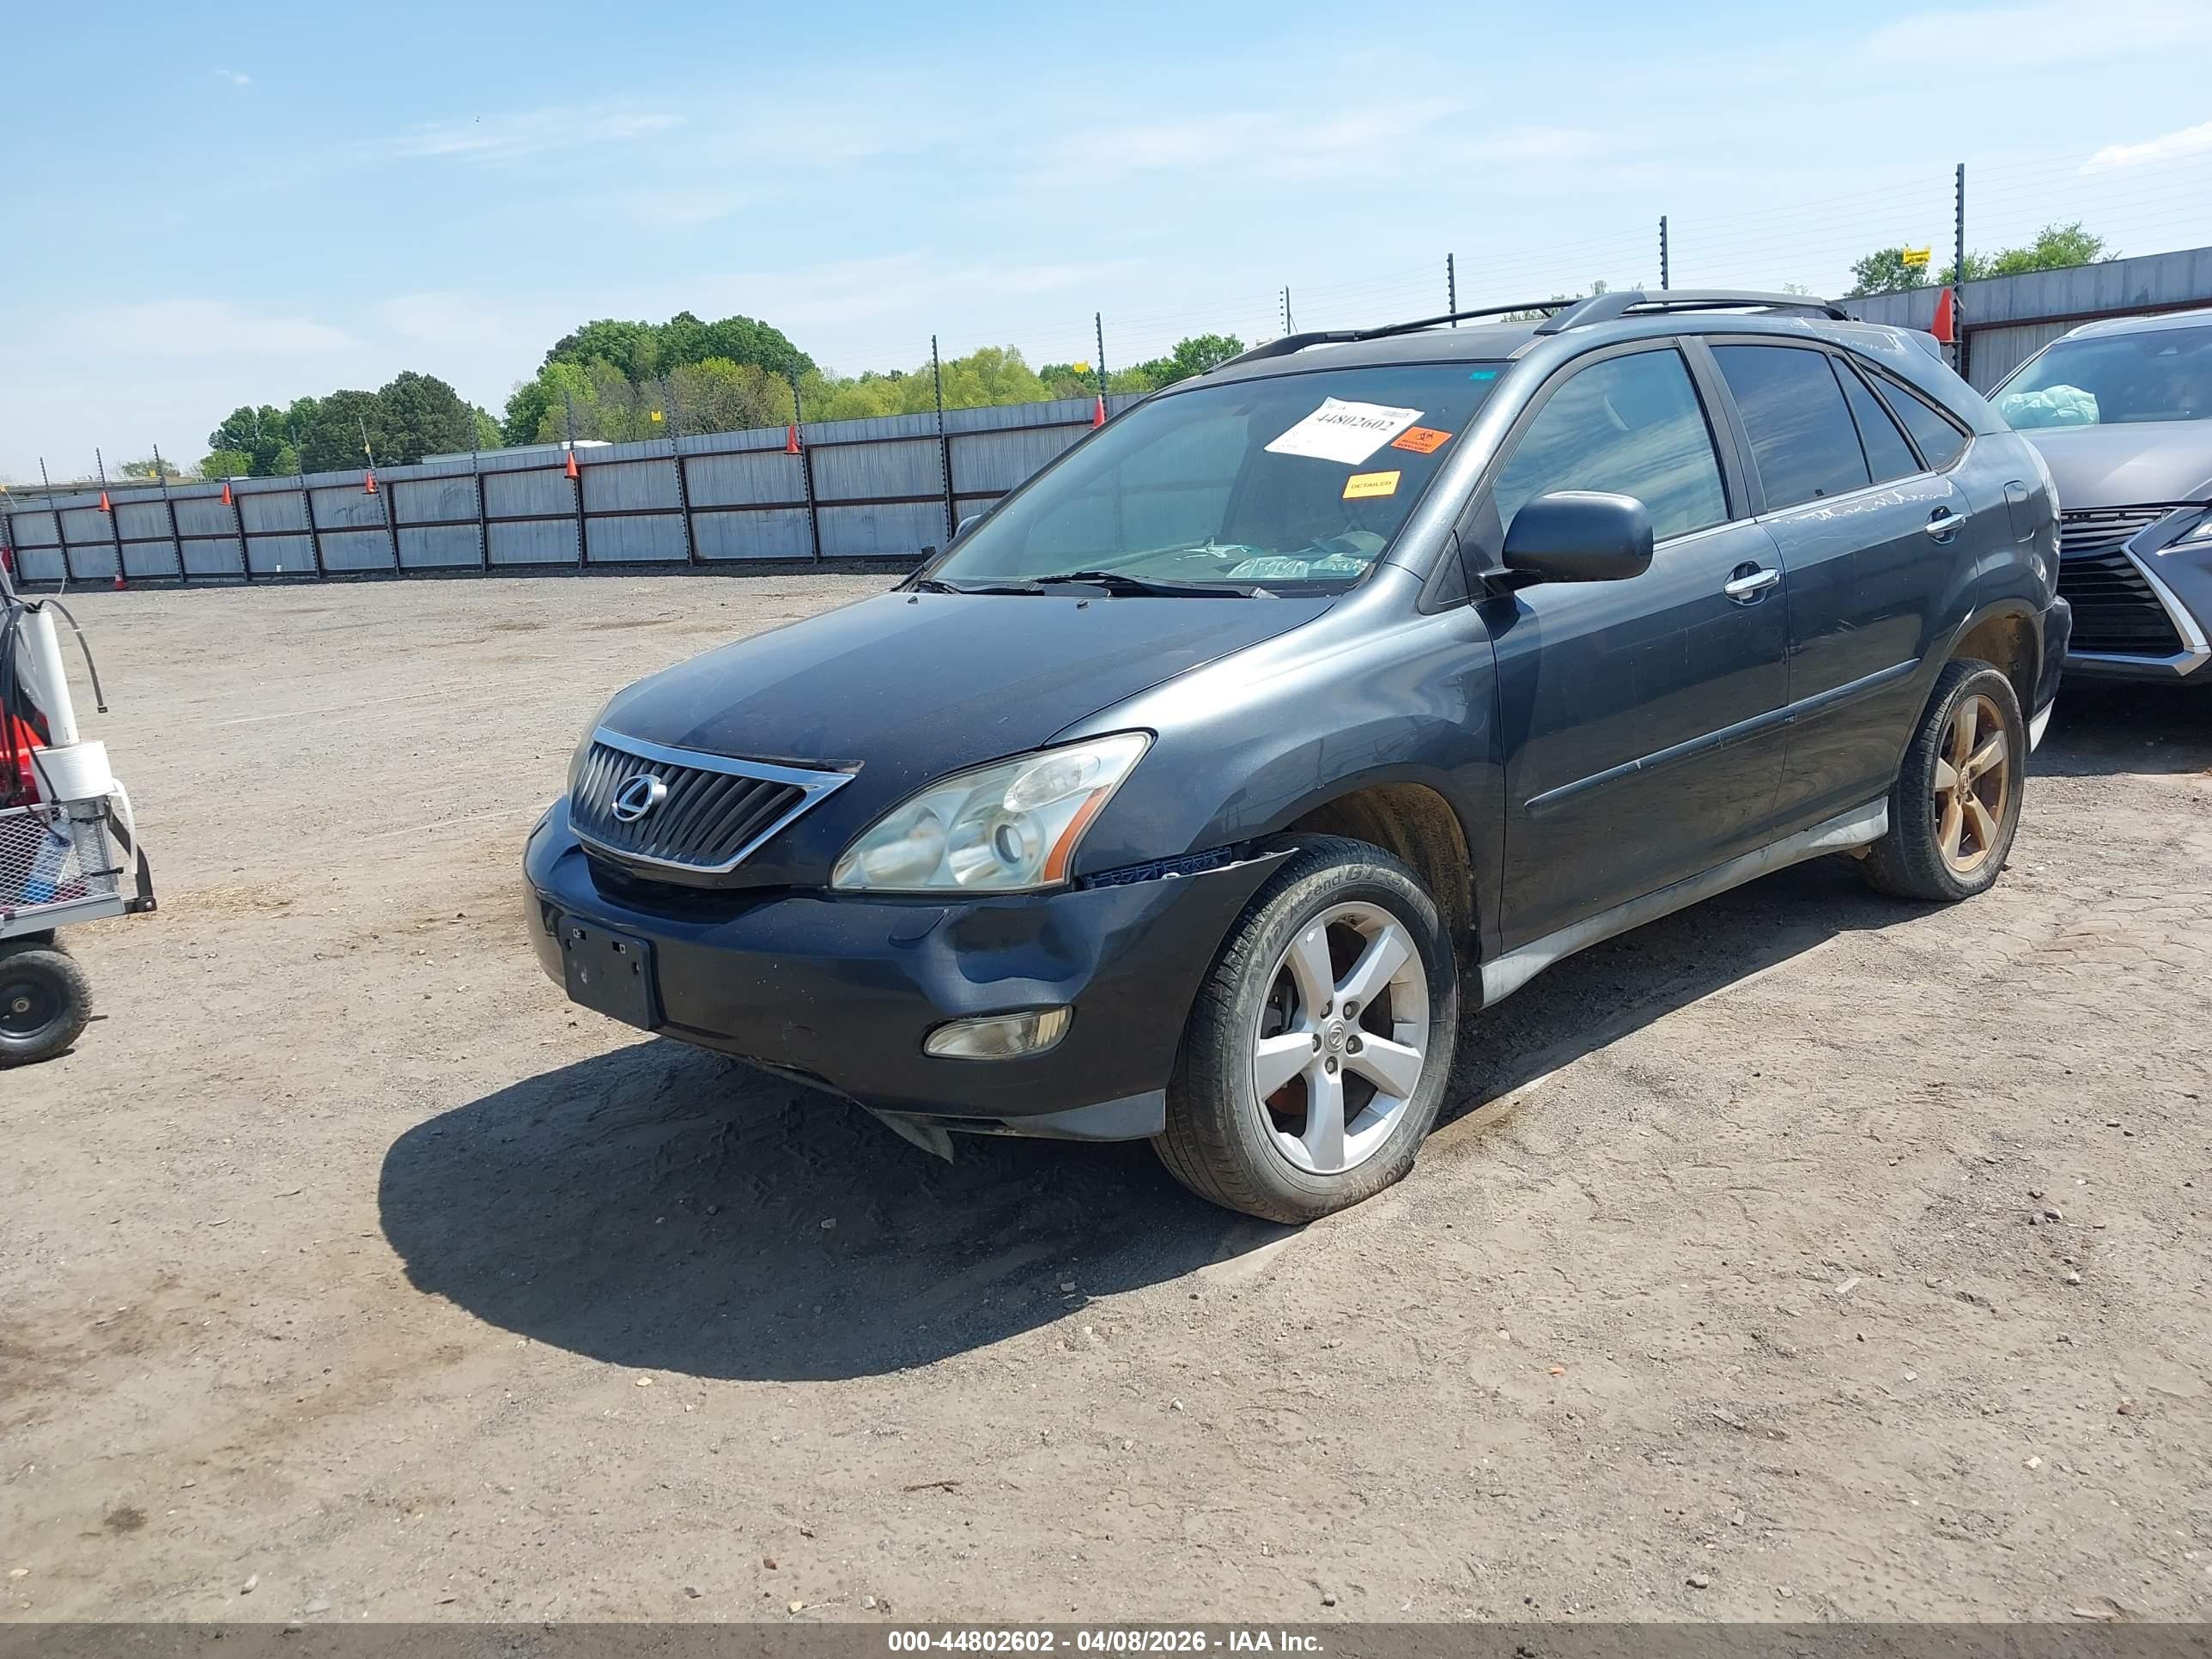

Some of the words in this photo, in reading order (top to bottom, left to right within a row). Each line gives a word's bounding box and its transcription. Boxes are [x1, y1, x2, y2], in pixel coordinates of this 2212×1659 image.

[1316, 412, 1395, 431] 44802602
[1351, 481, 1393, 489] DETAILED
[1289, 872, 1341, 919] Ascend
